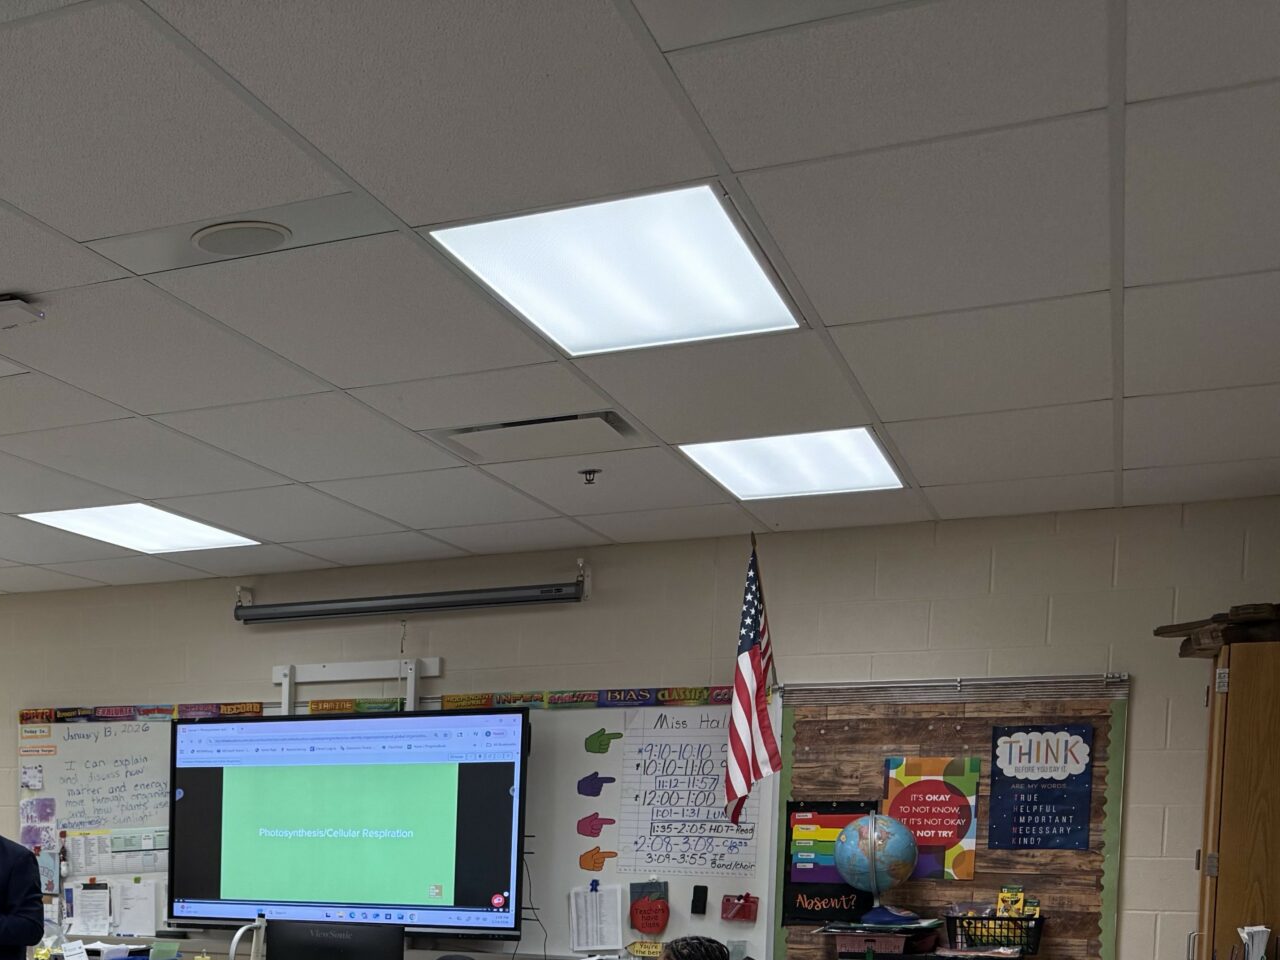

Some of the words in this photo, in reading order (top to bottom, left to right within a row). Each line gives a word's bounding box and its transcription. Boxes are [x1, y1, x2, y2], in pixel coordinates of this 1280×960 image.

[496, 694, 542, 704] INFER
[606, 690, 650, 700] BIAS
[656, 689, 710, 700] CLASSIFY
[220, 704, 260, 714] RECORD
[312, 702, 352, 710] EXAMINE
[654, 713, 688, 729] Miss
[63, 727, 99, 743] January
[122, 723, 150, 734] 2026
[644, 744, 712, 760] 9:10-10:10
[1003, 738, 1080, 765] THINK
[64, 761, 75, 771] I
[84, 760, 106, 768] can
[114, 755, 148, 767] explain
[642, 759, 714, 776] 10:10-11:10
[59, 773, 78, 784] and
[658, 778, 717, 789] 11:12-11:57
[68, 788, 101, 796] matter
[108, 782, 126, 793] and
[134, 780, 168, 791] energy
[642, 790, 716, 807] 12:00-1:00
[656, 808, 700, 818] 1:01-1:31
[258, 828, 360, 839] Photosynthesis/Cellular
[362, 828, 414, 839] Respiration
[652, 824, 707, 834] 1:35-2:05
[1012, 837, 1041, 845] KIND?
[645, 853, 707, 865] 3:09-3:55
[796, 894, 857, 910] Absent?
[636, 907, 665, 915] Teachers
[310, 930, 352, 939] ViewSonic
